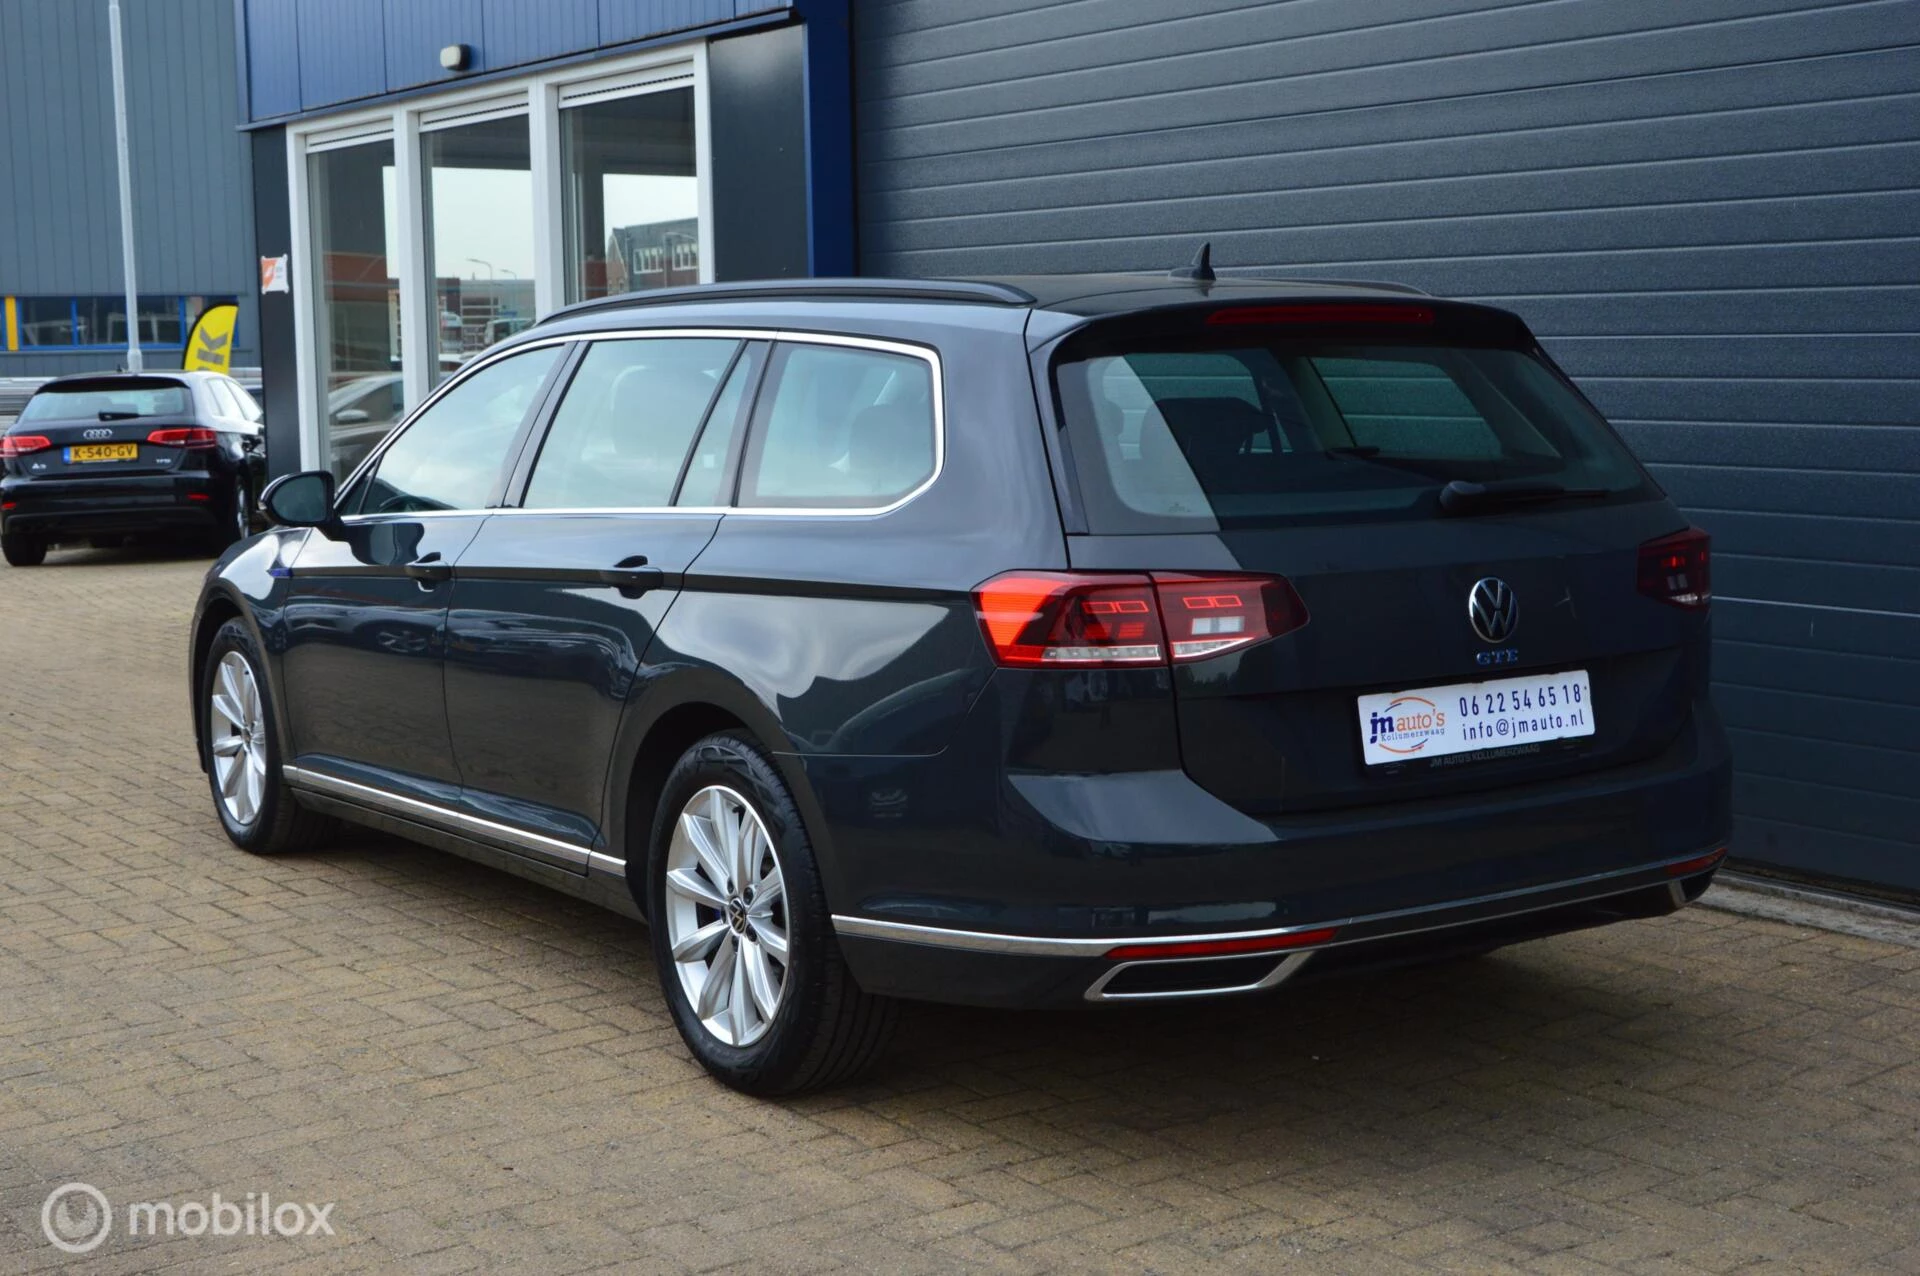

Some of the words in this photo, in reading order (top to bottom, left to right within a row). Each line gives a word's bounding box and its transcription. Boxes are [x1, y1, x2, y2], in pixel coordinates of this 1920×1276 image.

[196, 325, 228, 370] K
[73, 445, 134, 459] K-540-GV
[1476, 649, 1519, 665] GTE
[1462, 708, 1584, 741] info@jmauto.nl
[1380, 728, 1445, 742] Kollumerzwaag
